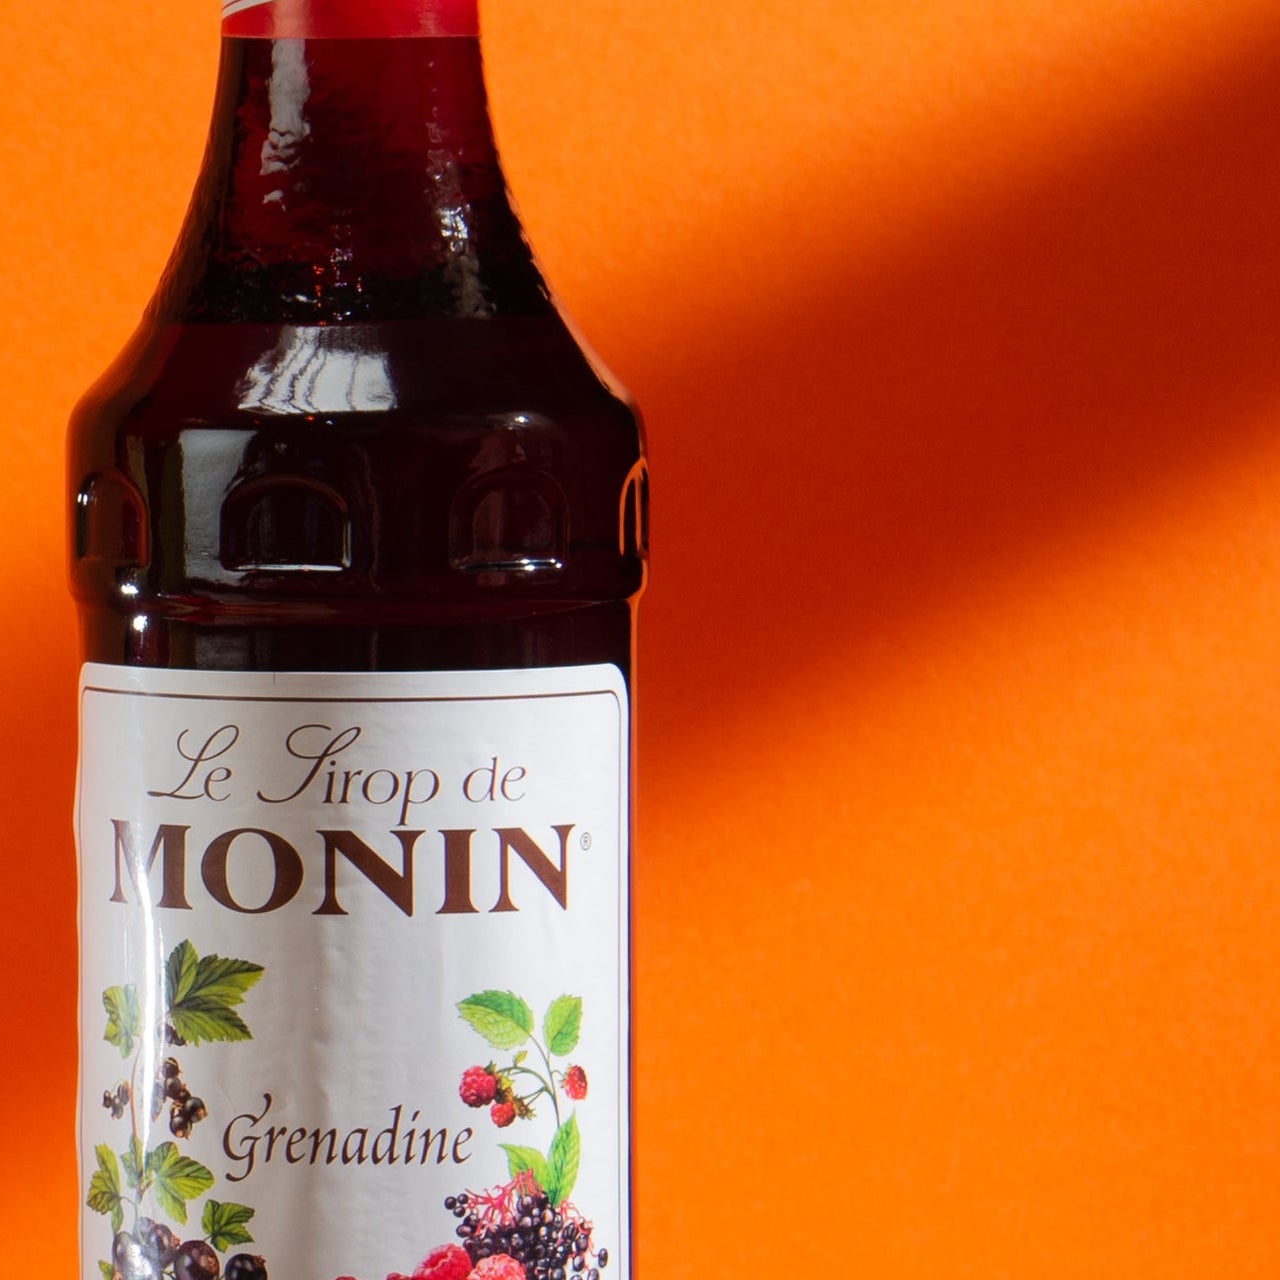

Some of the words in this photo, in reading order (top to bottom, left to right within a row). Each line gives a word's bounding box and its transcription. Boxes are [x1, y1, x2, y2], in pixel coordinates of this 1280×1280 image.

[147, 724, 239, 801] Le
[257, 724, 440, 826] Sirop
[462, 757, 527, 802] de
[222, 1092, 474, 1183] Grenadine
